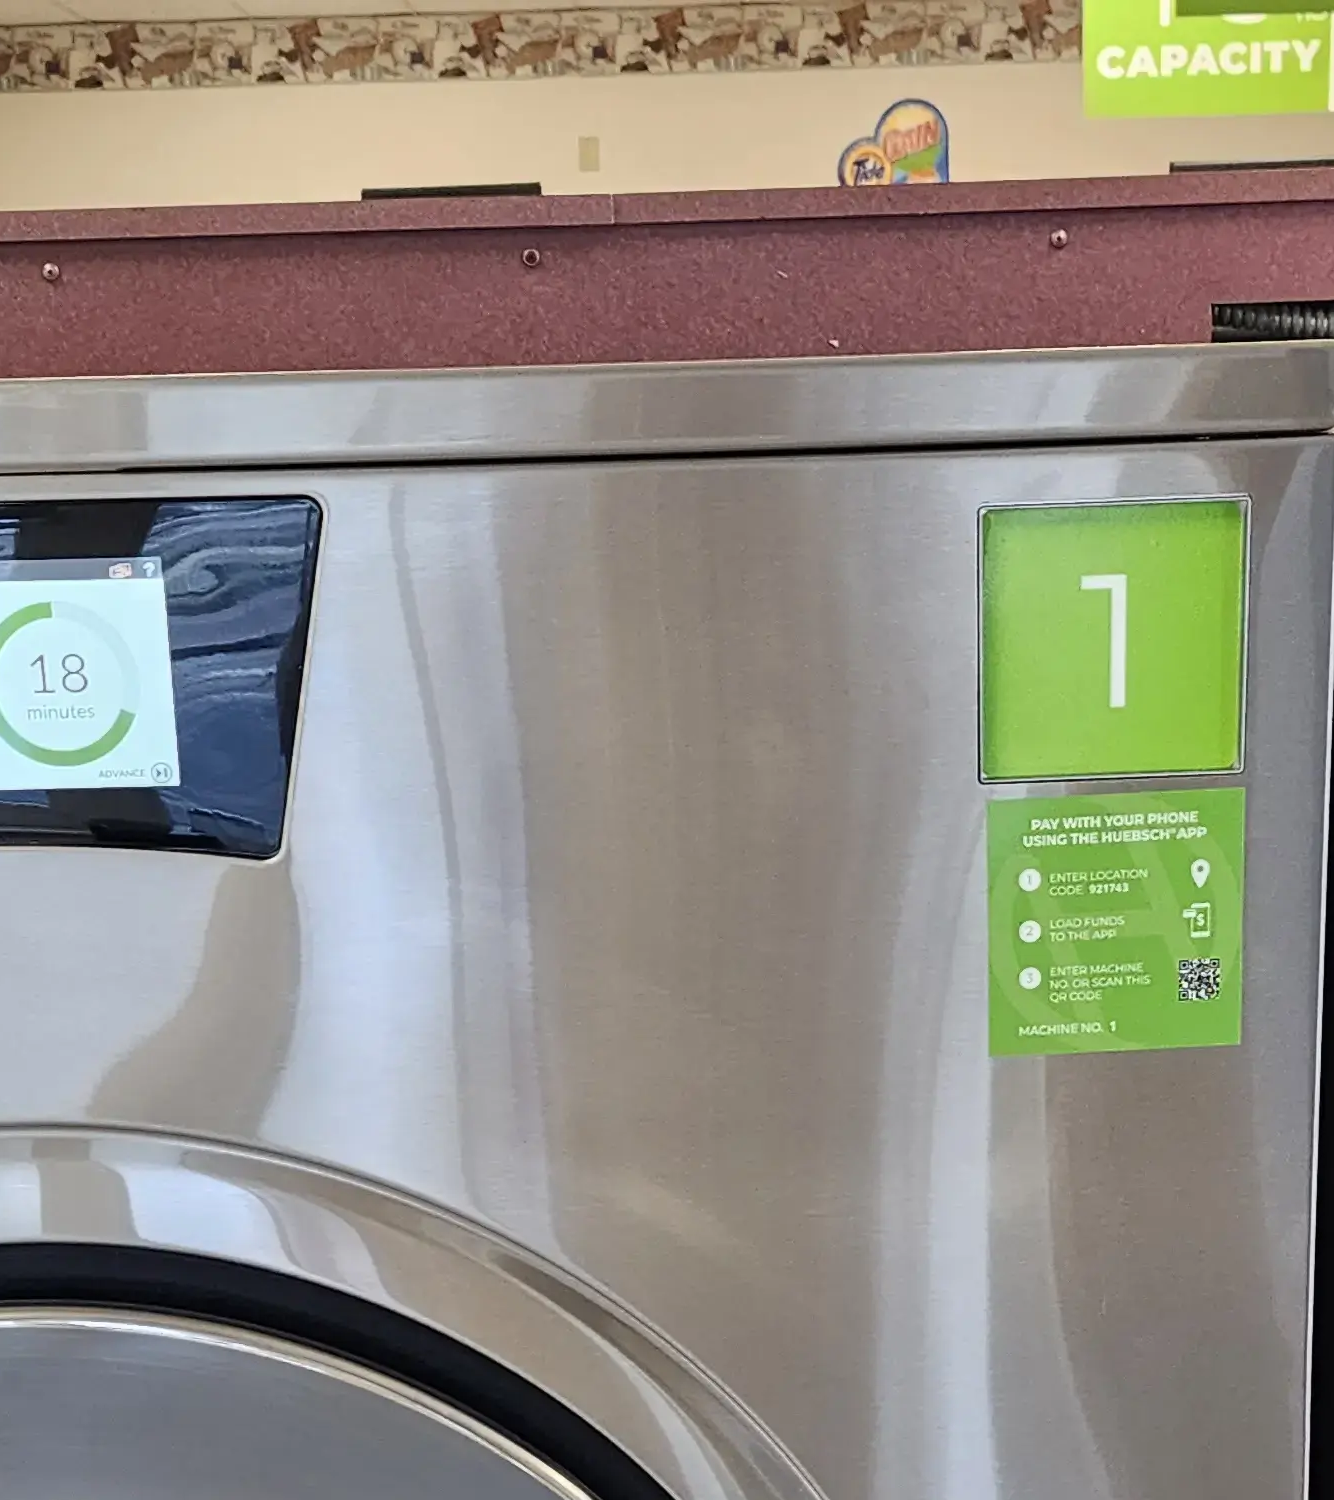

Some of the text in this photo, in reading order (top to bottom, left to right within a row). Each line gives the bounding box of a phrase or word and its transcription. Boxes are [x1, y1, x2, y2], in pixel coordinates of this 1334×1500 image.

[1096, 38, 1322, 80] CAPACITY
[1080, 574, 1128, 708] 1
[30, 653, 89, 693] 18
[27, 704, 95, 720] minutes
[98, 768, 145, 778] ADVANCE
[1030, 810, 1200, 831] PAY WITH YOUR PHONE
[1023, 833, 1068, 848] USING
[1070, 831, 1099, 845] THE
[1176, 826, 1208, 839] APP
[1049, 868, 1148, 883] ENTER LOCATION
[1049, 884, 1085, 896] CODE
[1049, 916, 1126, 929] LOAD FUNDS
[1049, 929, 1117, 942] TO THE APP
[1049, 962, 1144, 977] ENTER MACHINE
[1072, 978, 1090, 988] OR
[1091, 976, 1123, 988] SCAN
[1125, 974, 1152, 986] THIS
[1049, 990, 1102, 1003] QR CODE
[1018, 1023, 1079, 1037] MACHINE
[1080, 1021, 1104, 1034] NO.
